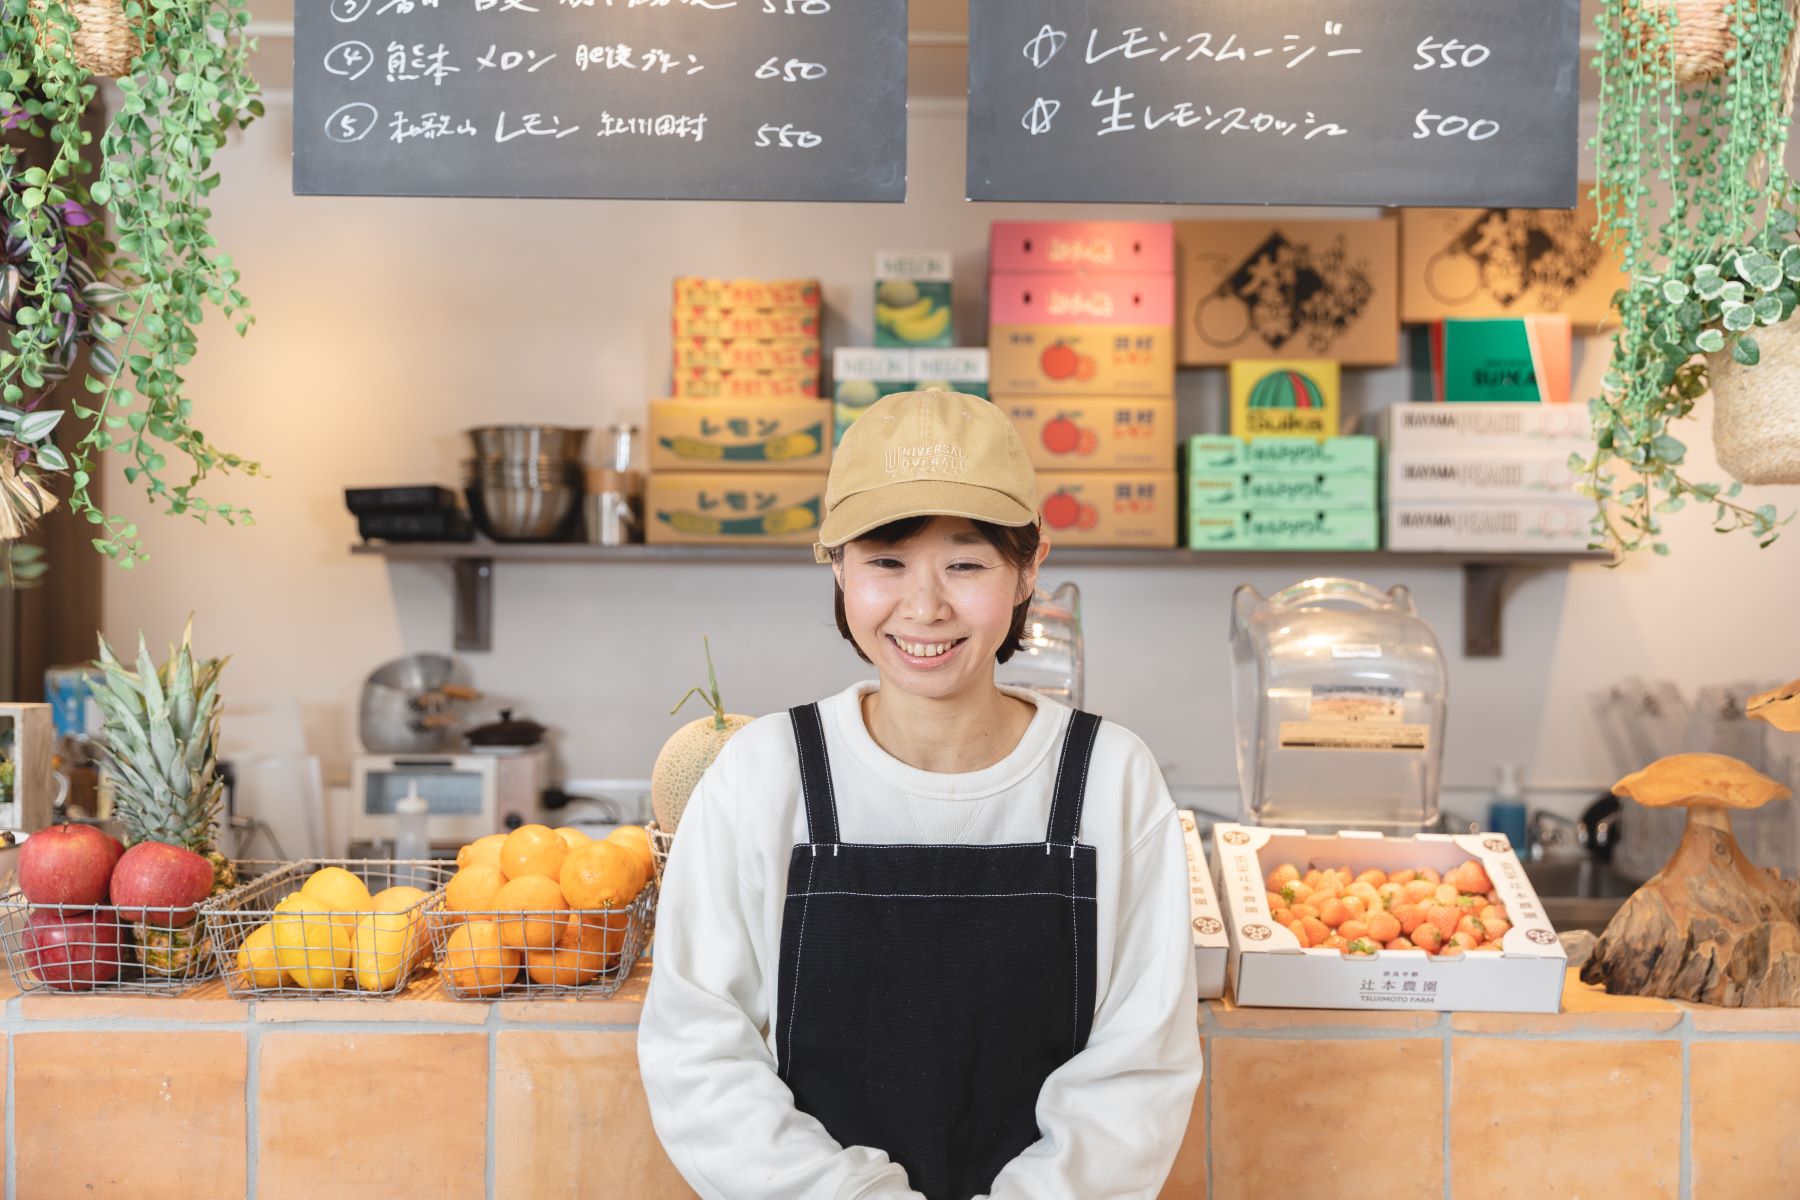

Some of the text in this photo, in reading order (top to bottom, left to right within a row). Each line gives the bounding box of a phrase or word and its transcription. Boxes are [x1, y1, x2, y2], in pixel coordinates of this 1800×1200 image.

[1085, 21, 1491, 70] レモンスムージー 550
[387, 41, 460, 86] 熊本
[477, 45, 557, 72] メロン
[755, 57, 827, 82] 650
[389, 111, 477, 143] 和歌山
[495, 111, 579, 142] レモン
[755, 124, 822, 148] 550
[1413, 109, 1500, 140] 500
[884, 257, 943, 273] MELON
[844, 357, 903, 373] MELON
[920, 357, 979, 373] MELON
[700, 416, 779, 437] レモン
[884, 444, 967, 473] UNIVERSAL
[902, 456, 968, 470] OVERALL
[698, 491, 777, 511] レモン
[1360, 979, 1438, 992] 辻本農園
[1360, 995, 1434, 1004] TSUJIMOTO FARM
